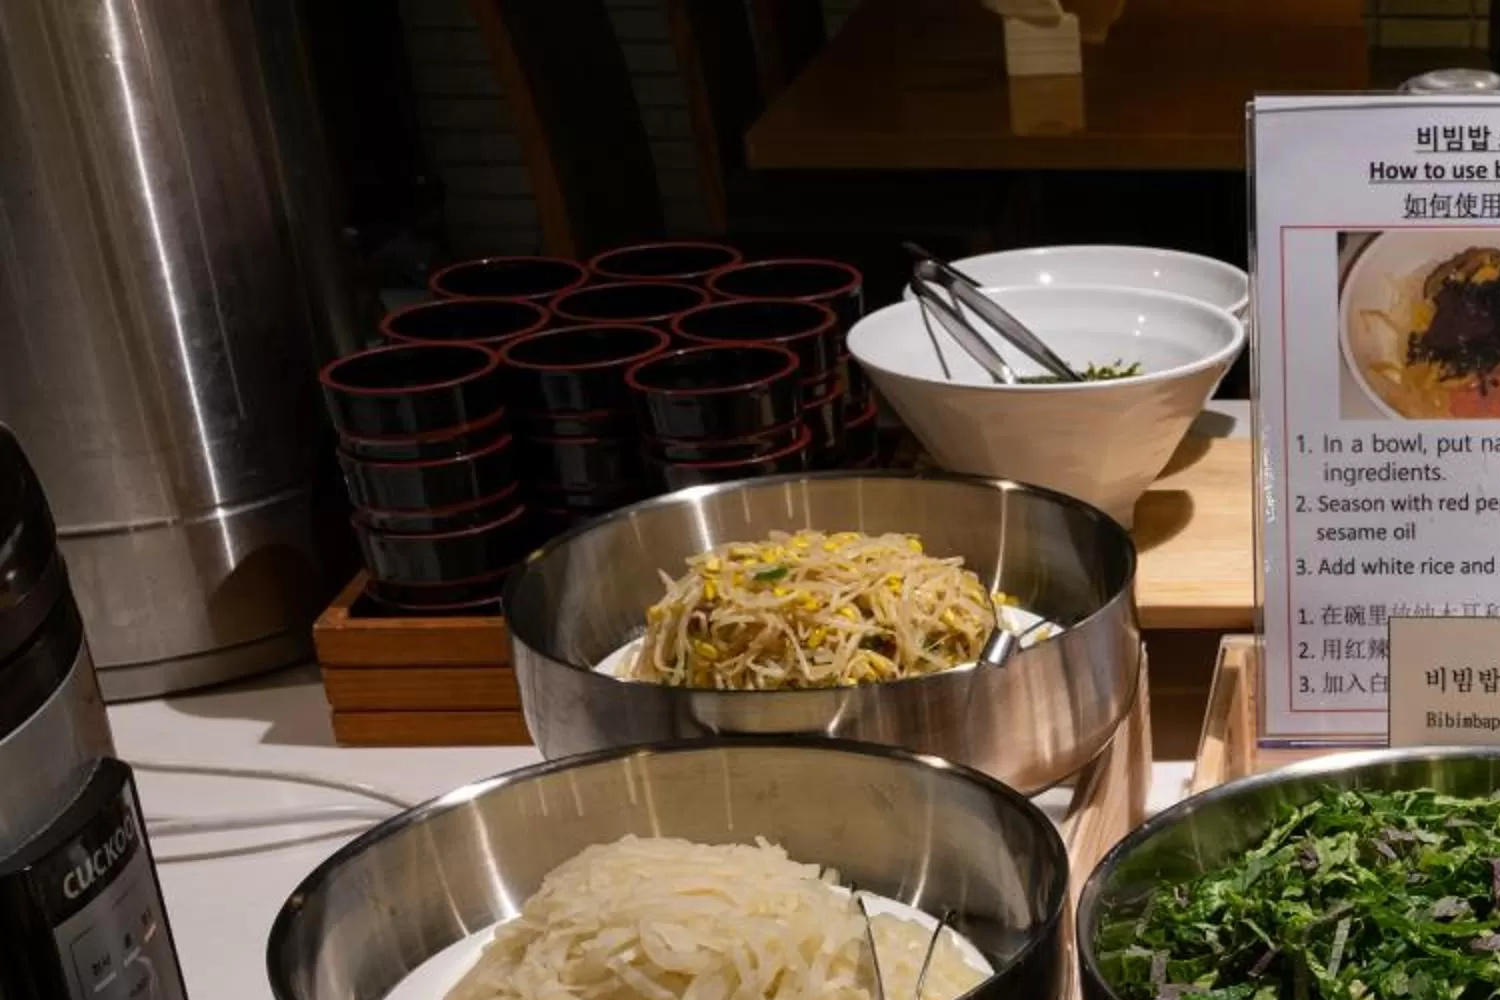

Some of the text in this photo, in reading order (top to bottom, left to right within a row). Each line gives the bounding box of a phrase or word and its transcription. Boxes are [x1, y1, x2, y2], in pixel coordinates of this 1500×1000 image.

[1417, 125, 1491, 151] 비빔밥
[1369, 161, 1418, 179] How
[1424, 162, 1446, 179] to
[1452, 163, 1487, 179] use
[1297, 434, 1313, 454] 1.
[1324, 434, 1342, 454] In
[1351, 439, 1364, 454] a
[1372, 434, 1426, 457] bowl,
[1437, 436, 1472, 457] put
[1323, 462, 1446, 487] ingredients.
[1295, 496, 1312, 513] 2.
[1318, 495, 1385, 513] Season
[1391, 495, 1432, 512] with
[1438, 495, 1469, 512] red
[1316, 523, 1416, 542] sesame oil
[1295, 559, 1312, 575] 3.
[1318, 557, 1355, 575] Add
[1361, 557, 1414, 575] white
[1420, 557, 1454, 575] rice
[1460, 557, 1495, 575] and
[1299, 608, 1314, 625] 1.
[1299, 641, 1316, 659] 2.
[1299, 675, 1316, 693] 3.
[1426, 712, 1500, 730] Bibimbap
[61, 814, 138, 900] CUCKOO
